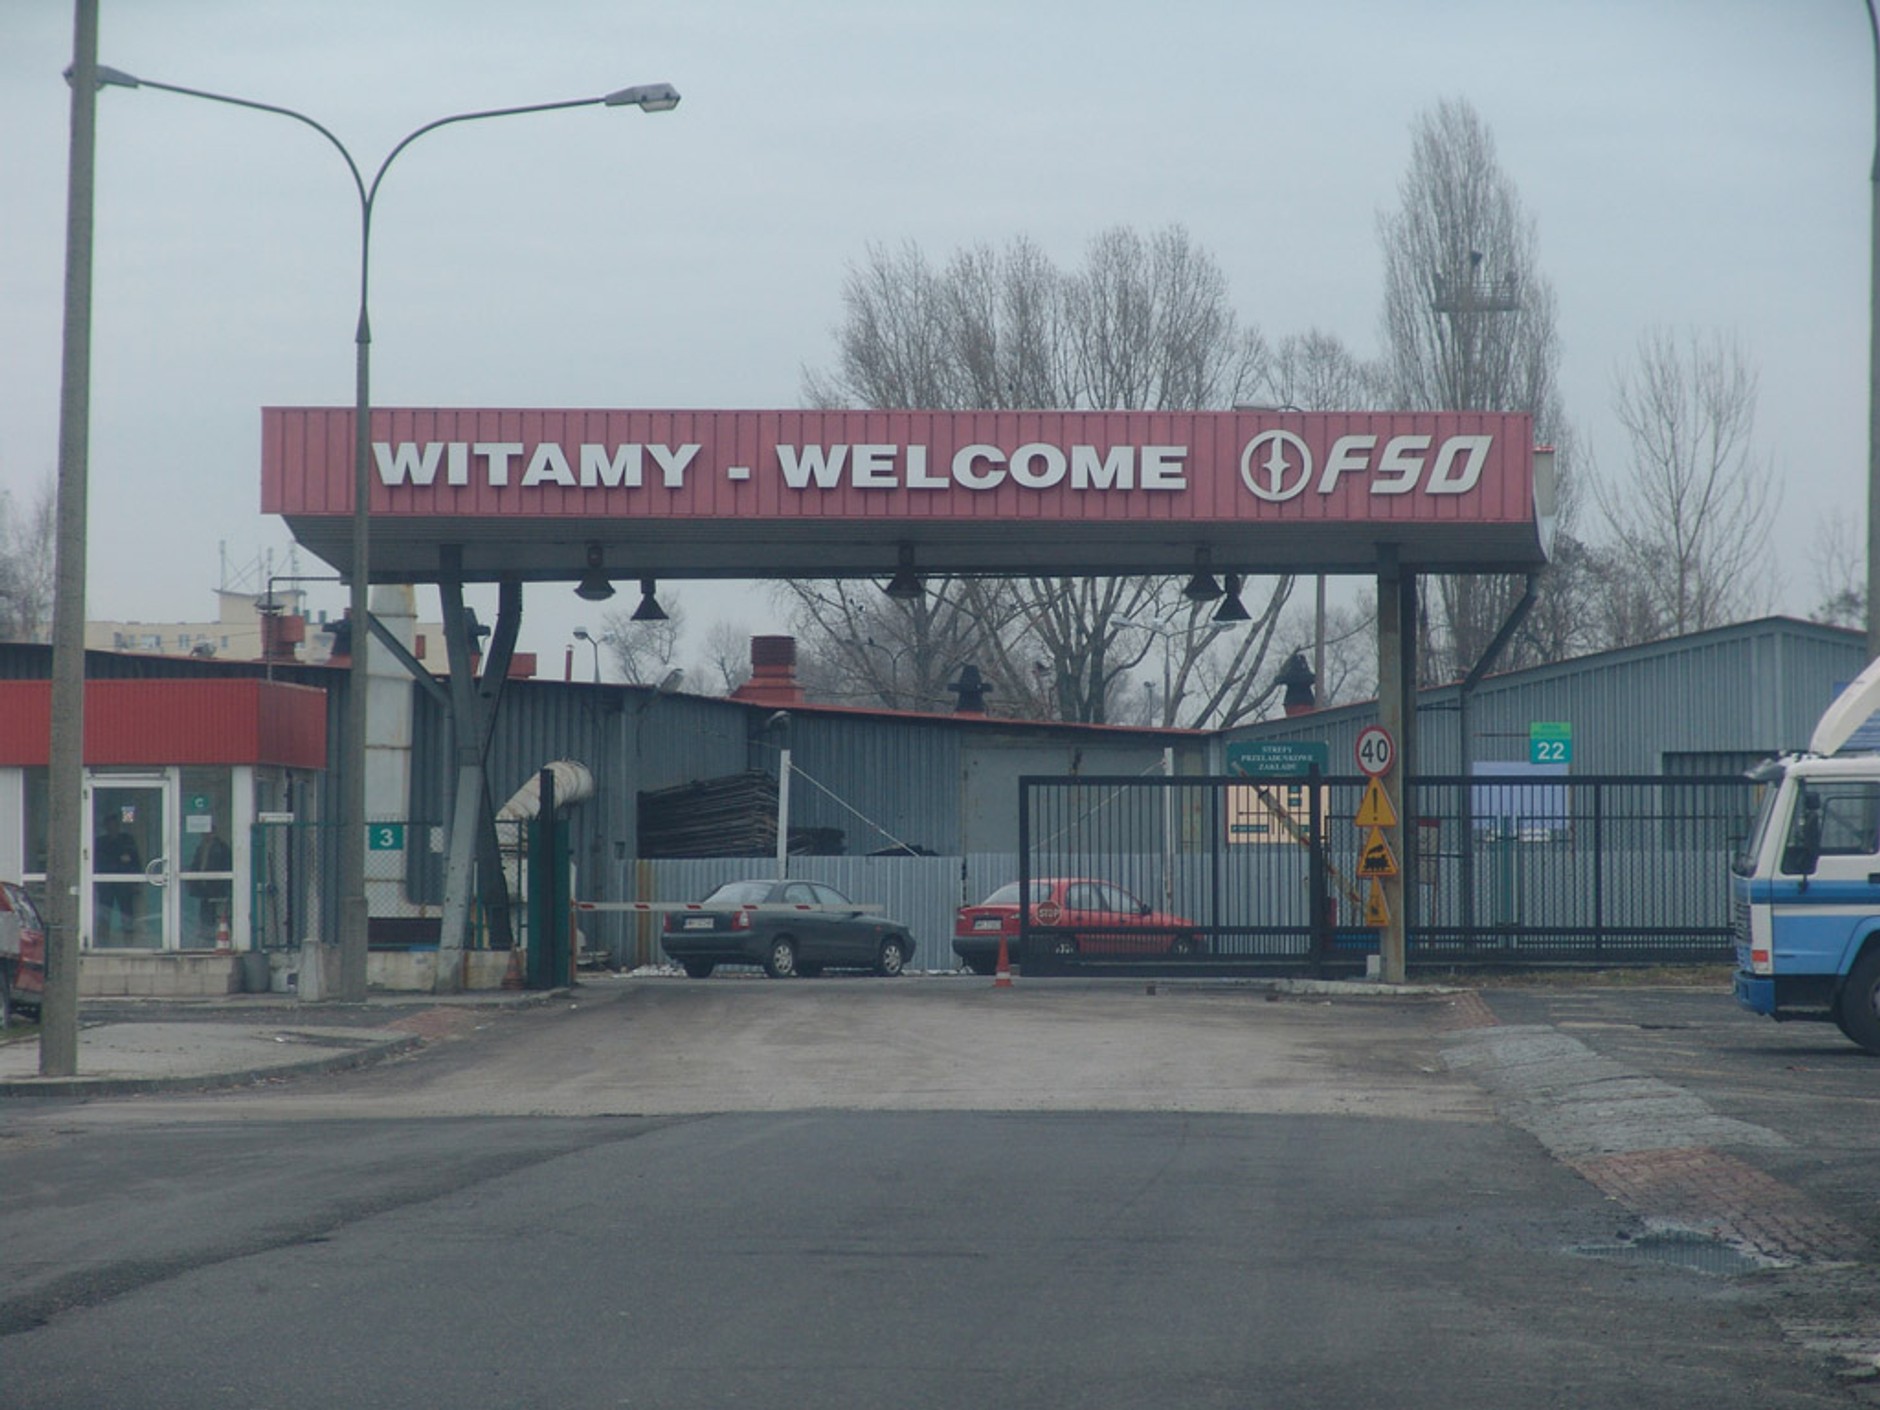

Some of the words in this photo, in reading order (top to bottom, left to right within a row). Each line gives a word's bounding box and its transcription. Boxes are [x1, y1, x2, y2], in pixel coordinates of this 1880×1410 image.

[371, 441, 702, 488] WITAMY
[728, 466, 751, 480] -
[775, 442, 1188, 490] WELCOME
[1317, 434, 1494, 494] FSO
[1361, 738, 1388, 763] 40
[1537, 742, 1565, 760] 22
[379, 828, 394, 847] 3
[1038, 908, 1061, 918] STOP
